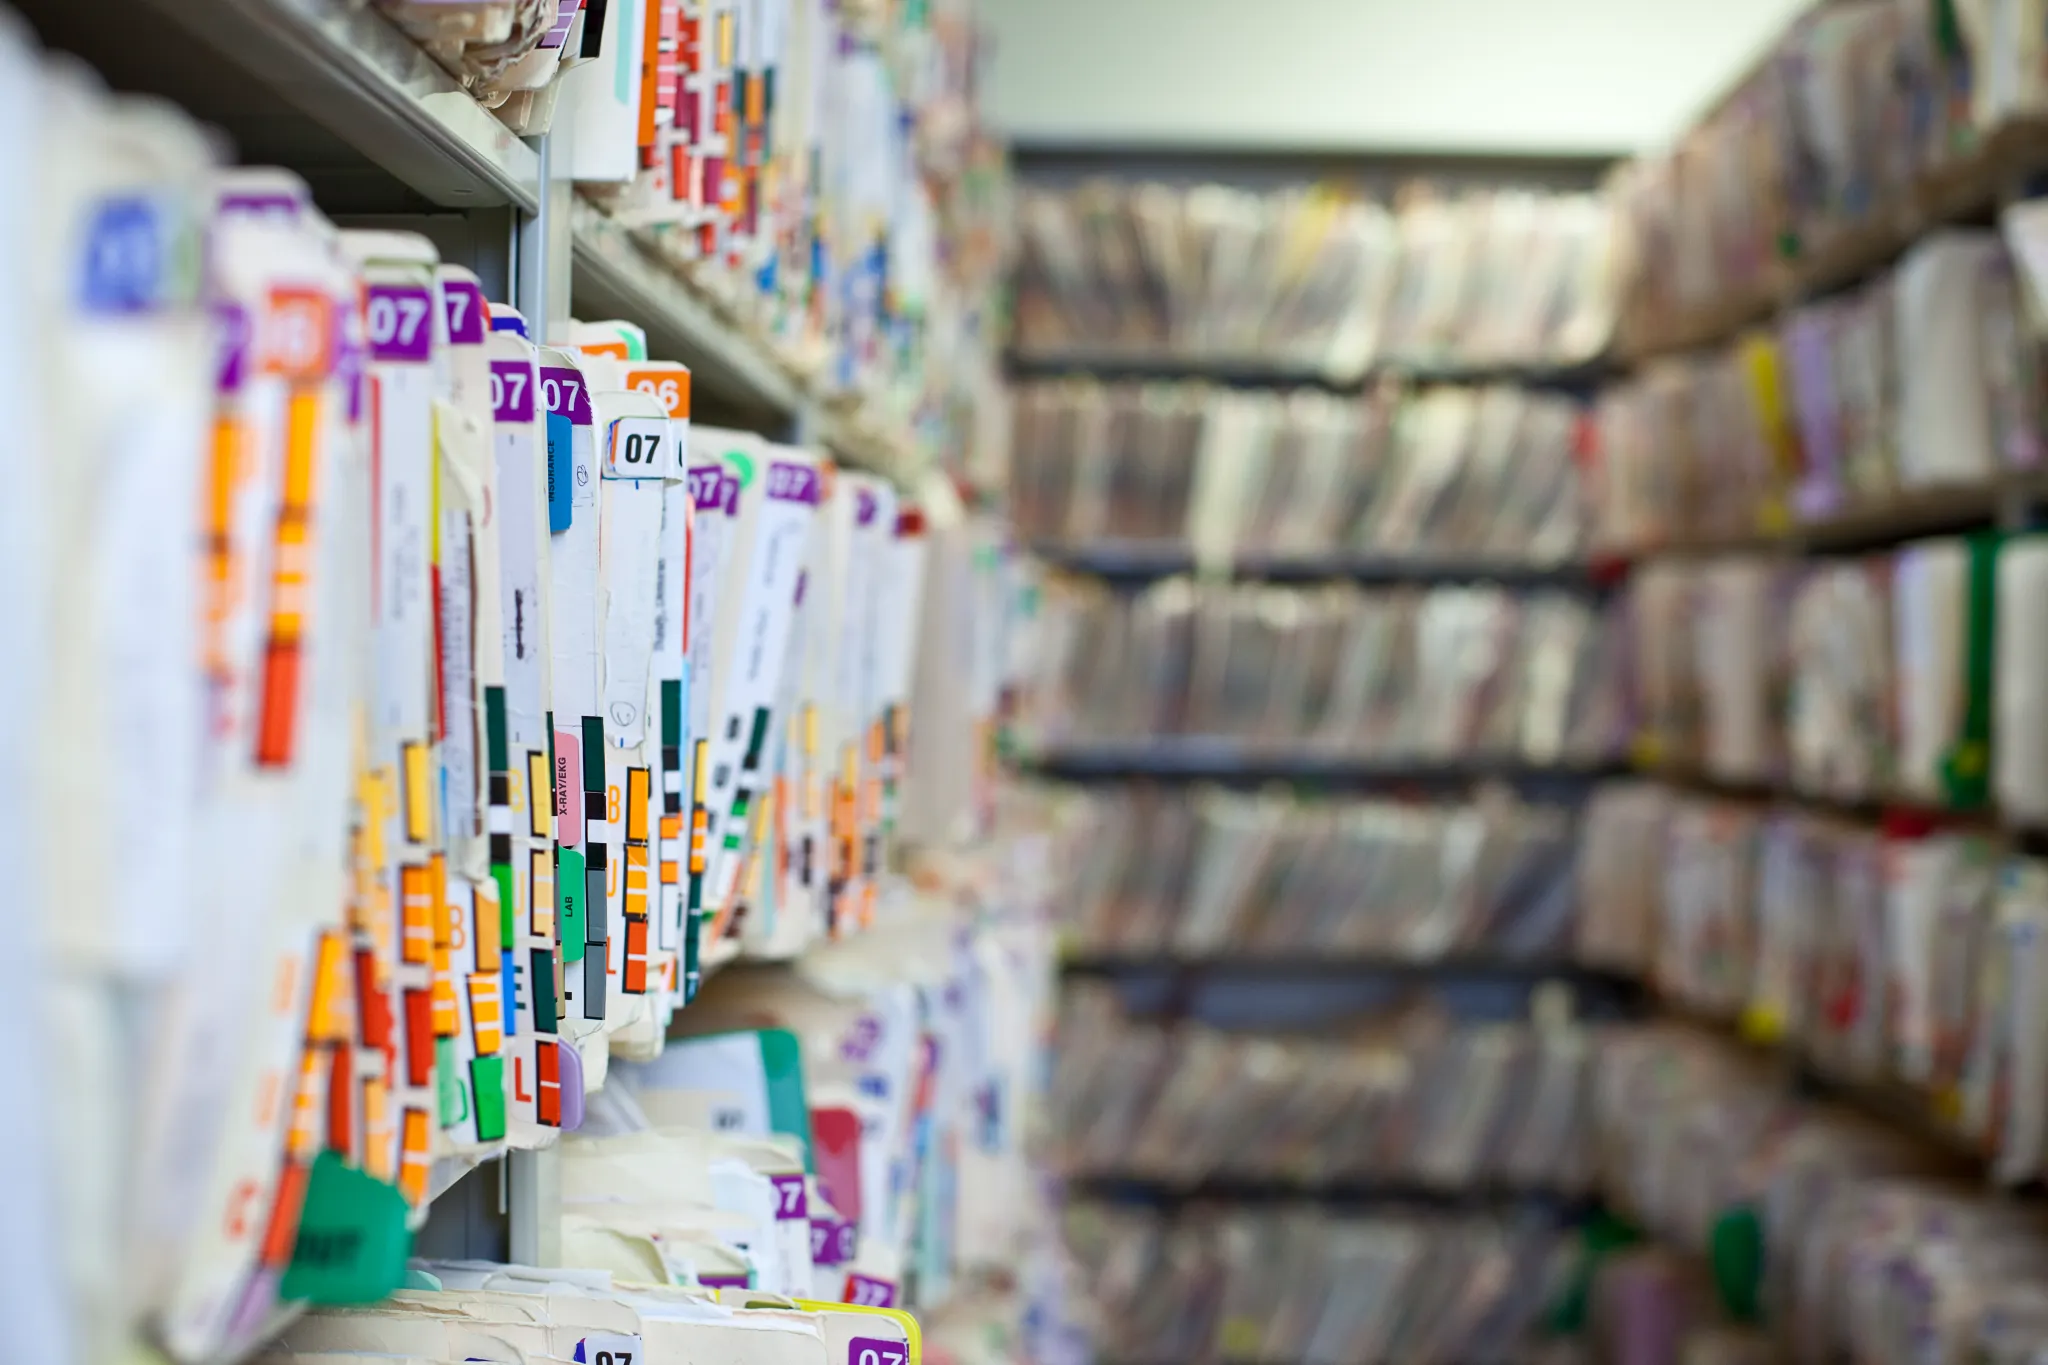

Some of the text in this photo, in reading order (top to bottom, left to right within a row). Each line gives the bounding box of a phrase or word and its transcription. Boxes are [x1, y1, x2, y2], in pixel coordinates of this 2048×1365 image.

[369, 296, 427, 346] 07
[541, 379, 580, 412] 07
[625, 433, 660, 464] 07
[547, 440, 555, 502] INSURANCE
[558, 757, 567, 815] X-RAY/EKG
[608, 784, 621, 824] B
[565, 896, 573, 918] LAB
[515, 1056, 532, 1103] L
